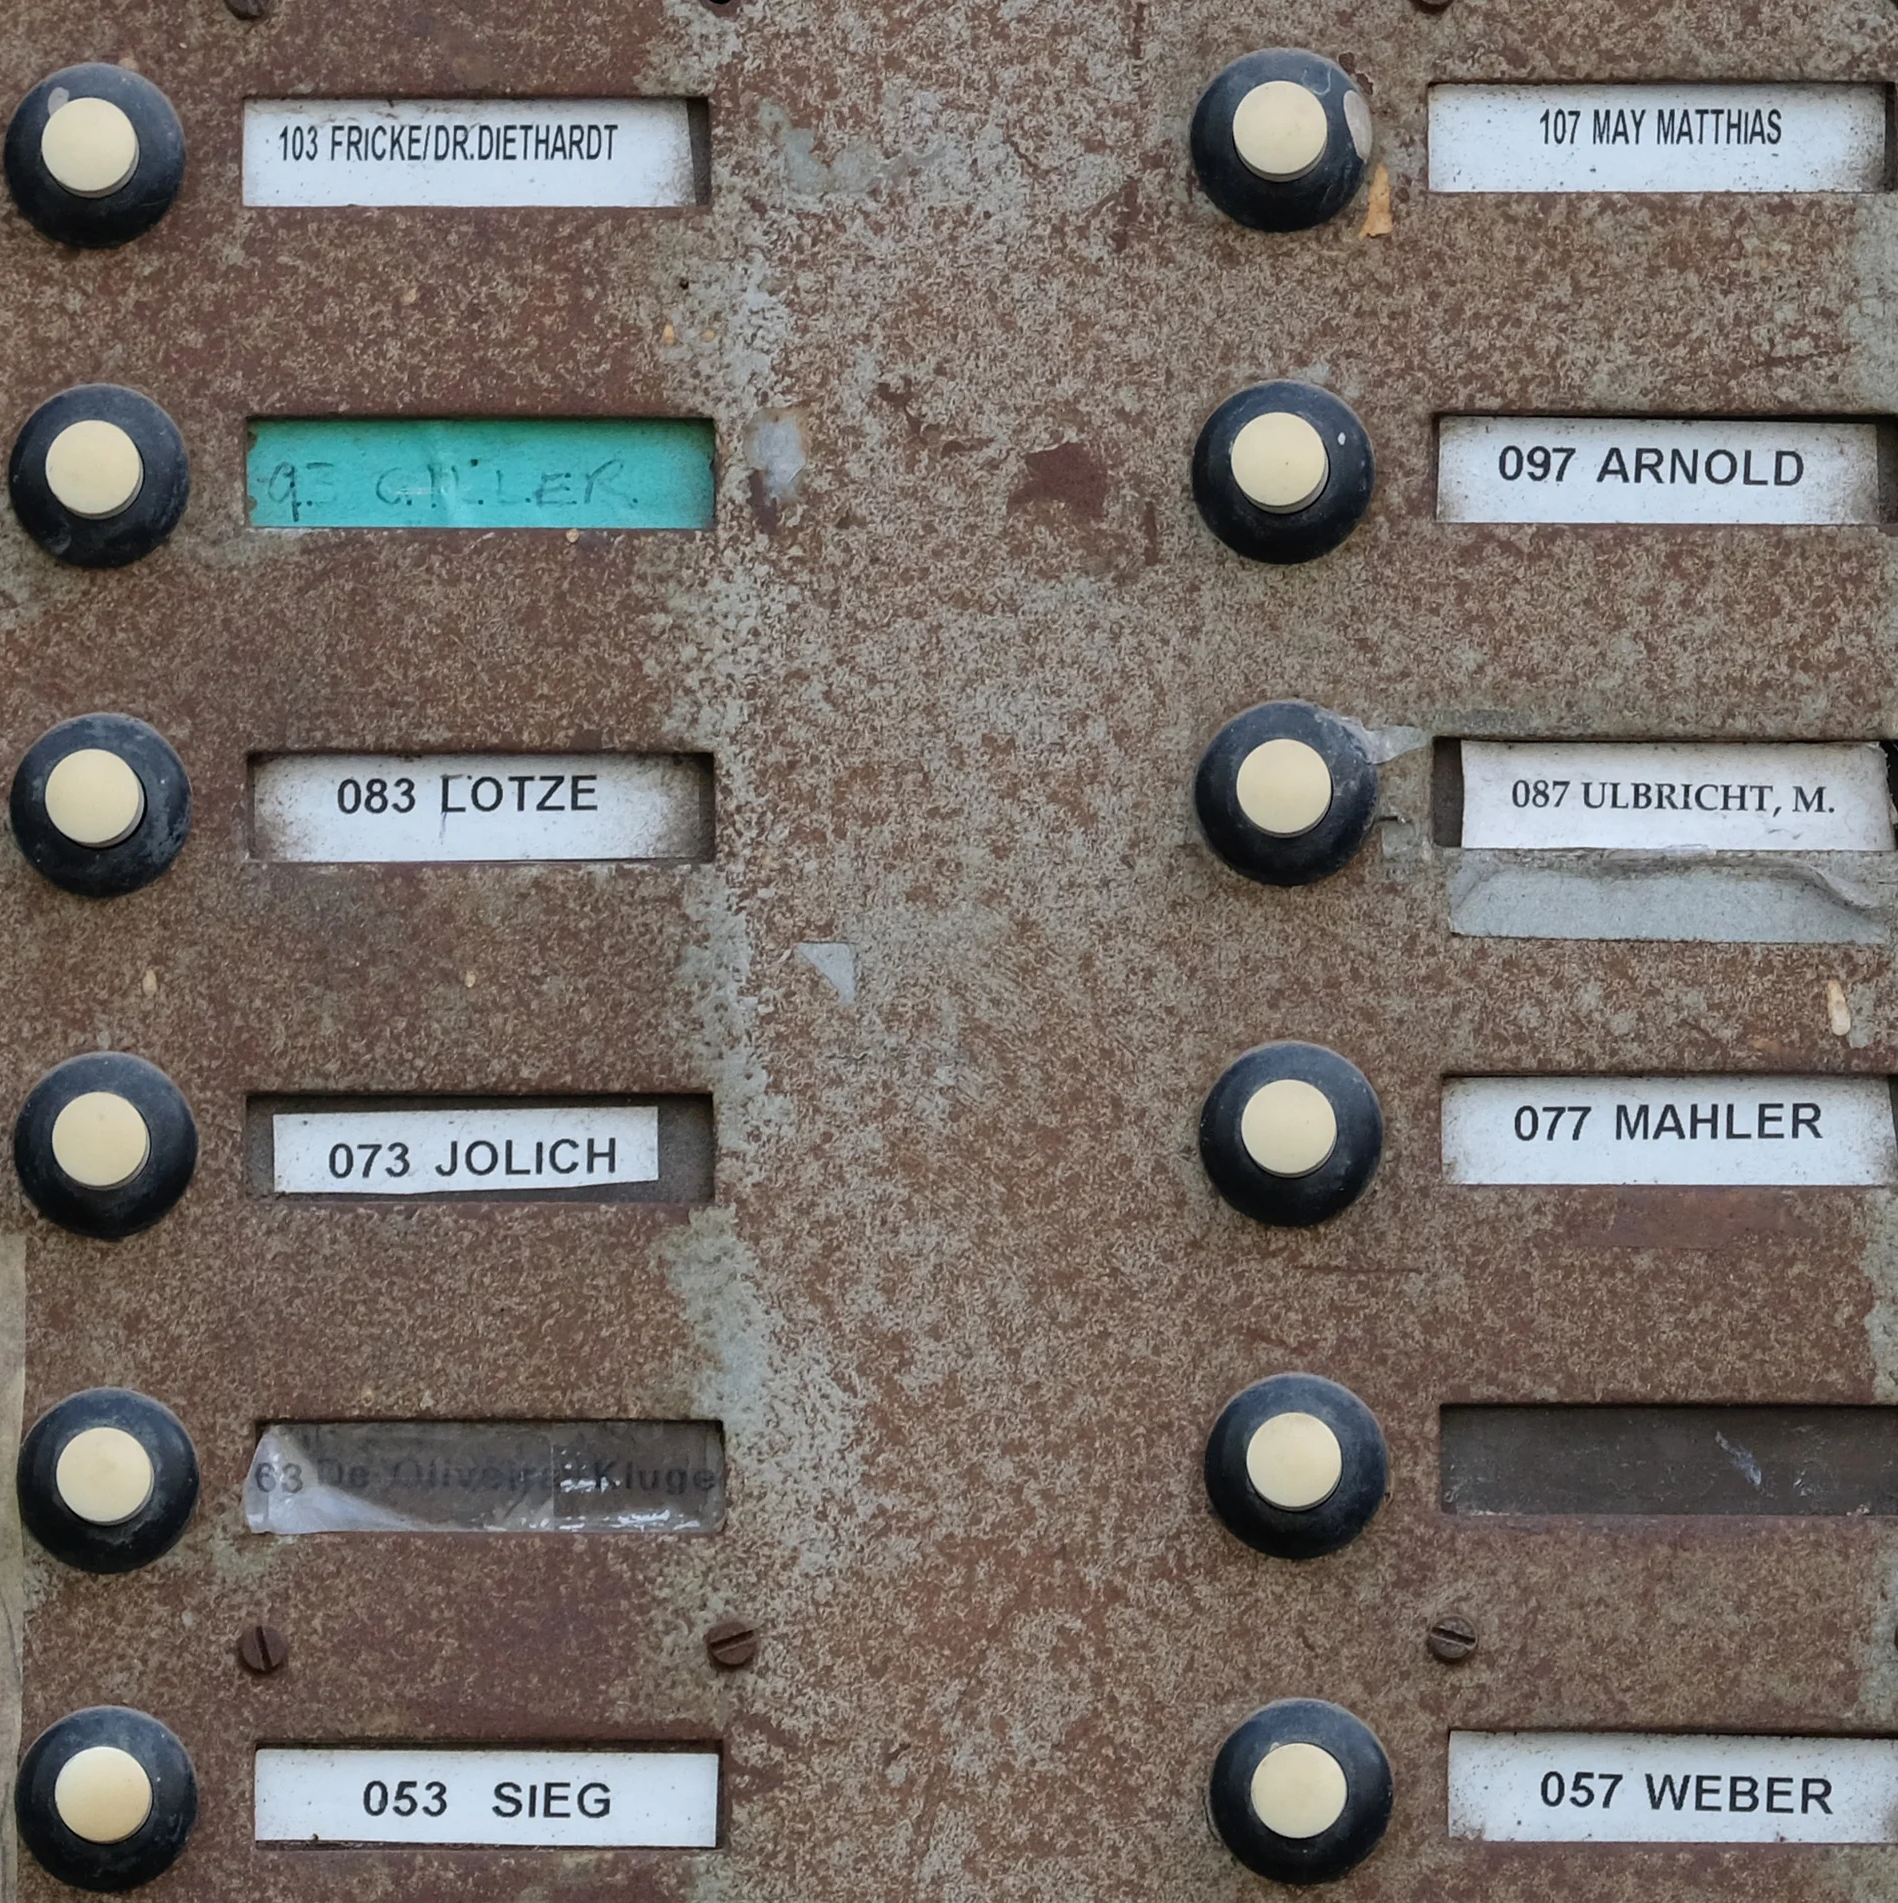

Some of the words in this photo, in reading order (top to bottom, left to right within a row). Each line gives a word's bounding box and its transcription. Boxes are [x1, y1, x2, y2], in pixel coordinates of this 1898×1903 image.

[279, 125, 318, 161] 103
[330, 124, 619, 161] FRICKE/DR.DIETHARDT
[1539, 108, 1581, 145] 107
[1592, 108, 1647, 145] MAY
[1656, 108, 1782, 145] MATTHIAS
[1498, 445, 1577, 482] 097
[1596, 446, 1805, 487] ARNOLD
[337, 777, 416, 815] 083
[439, 773, 598, 810] LOTZE
[1511, 779, 1571, 808] 087
[1580, 781, 1782, 818] ULBRICHT,
[1792, 785, 1835, 814] M.
[1514, 1105, 1592, 1142] 077
[1615, 1102, 1823, 1141] MAHLER
[328, 1141, 411, 1179] 073
[435, 1137, 616, 1177] JOLICH
[363, 1780, 448, 1817] 053
[491, 1781, 611, 1819] SIEG
[1540, 1770, 1624, 1809] 057
[1644, 1773, 1833, 1815] WEBER
